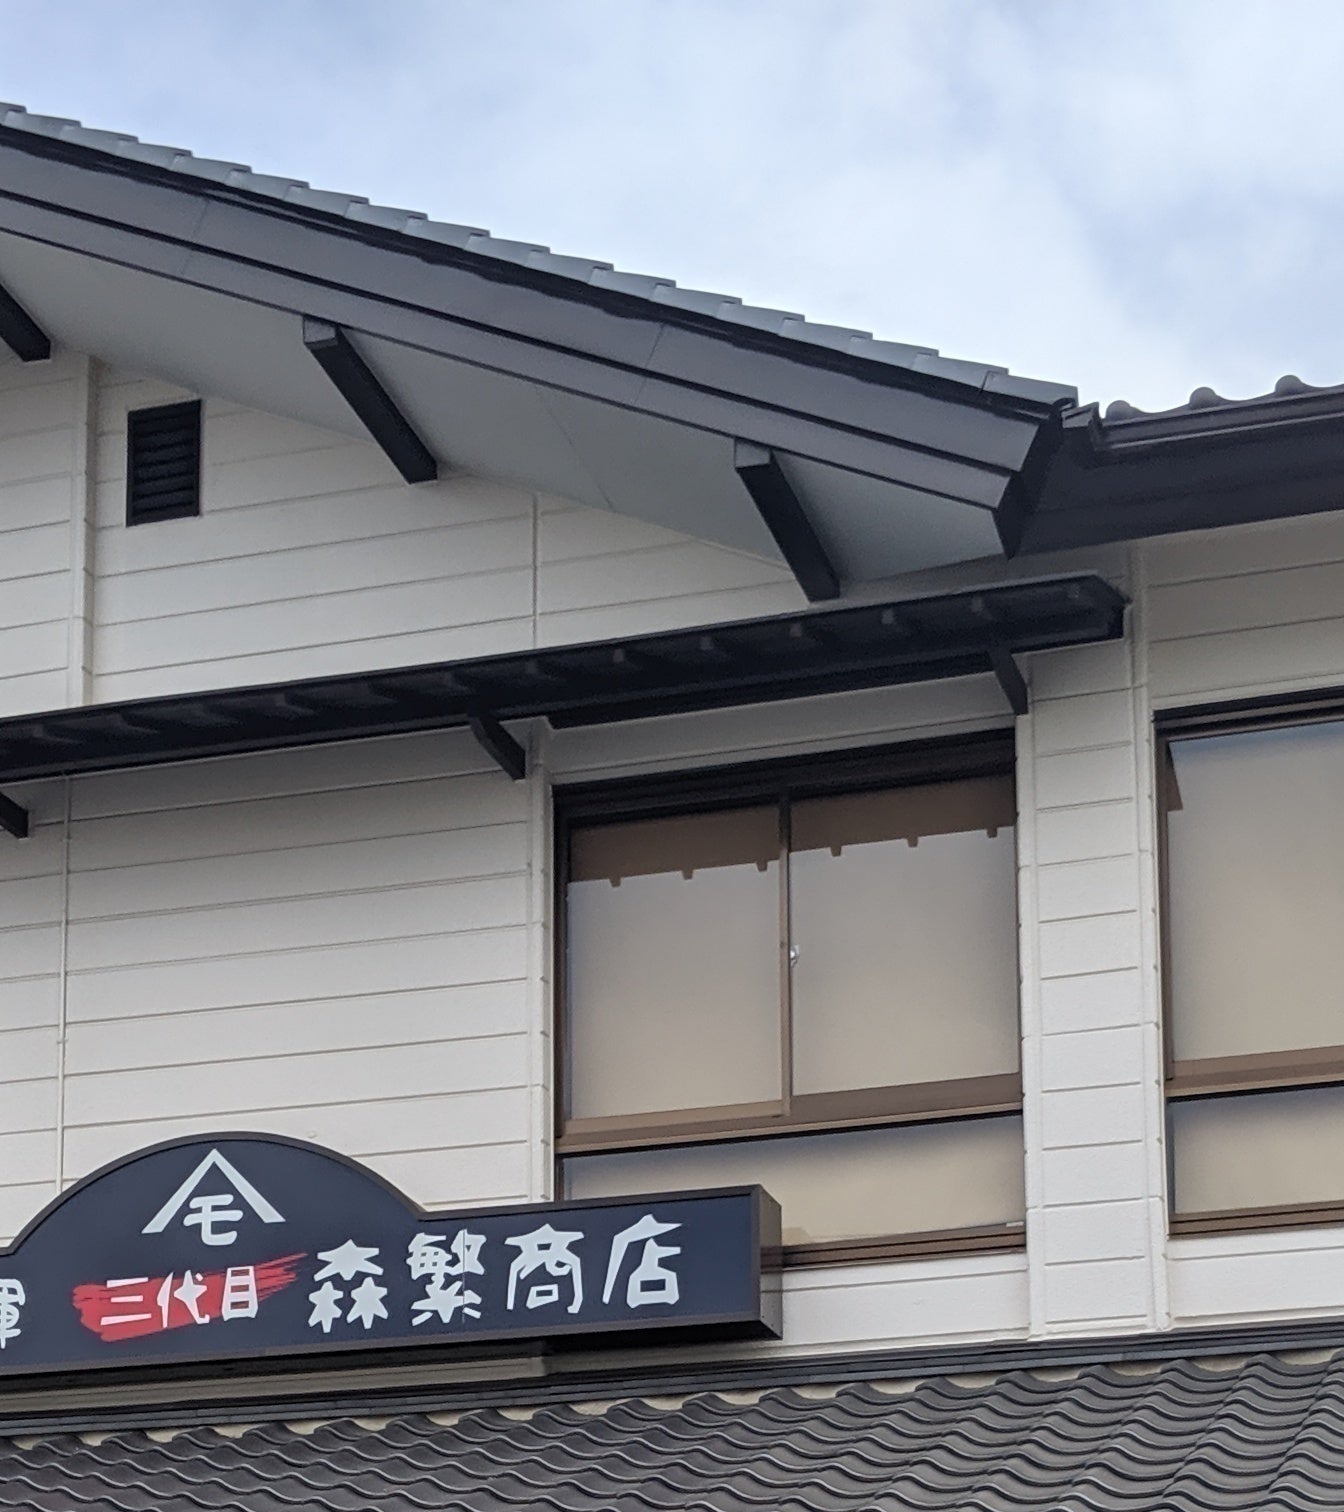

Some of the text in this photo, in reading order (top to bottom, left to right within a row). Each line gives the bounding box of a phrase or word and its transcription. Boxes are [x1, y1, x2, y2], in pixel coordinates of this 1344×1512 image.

[98, 1265, 259, 1325] 三代目
[308, 1213, 682, 1335] 森繁商店
